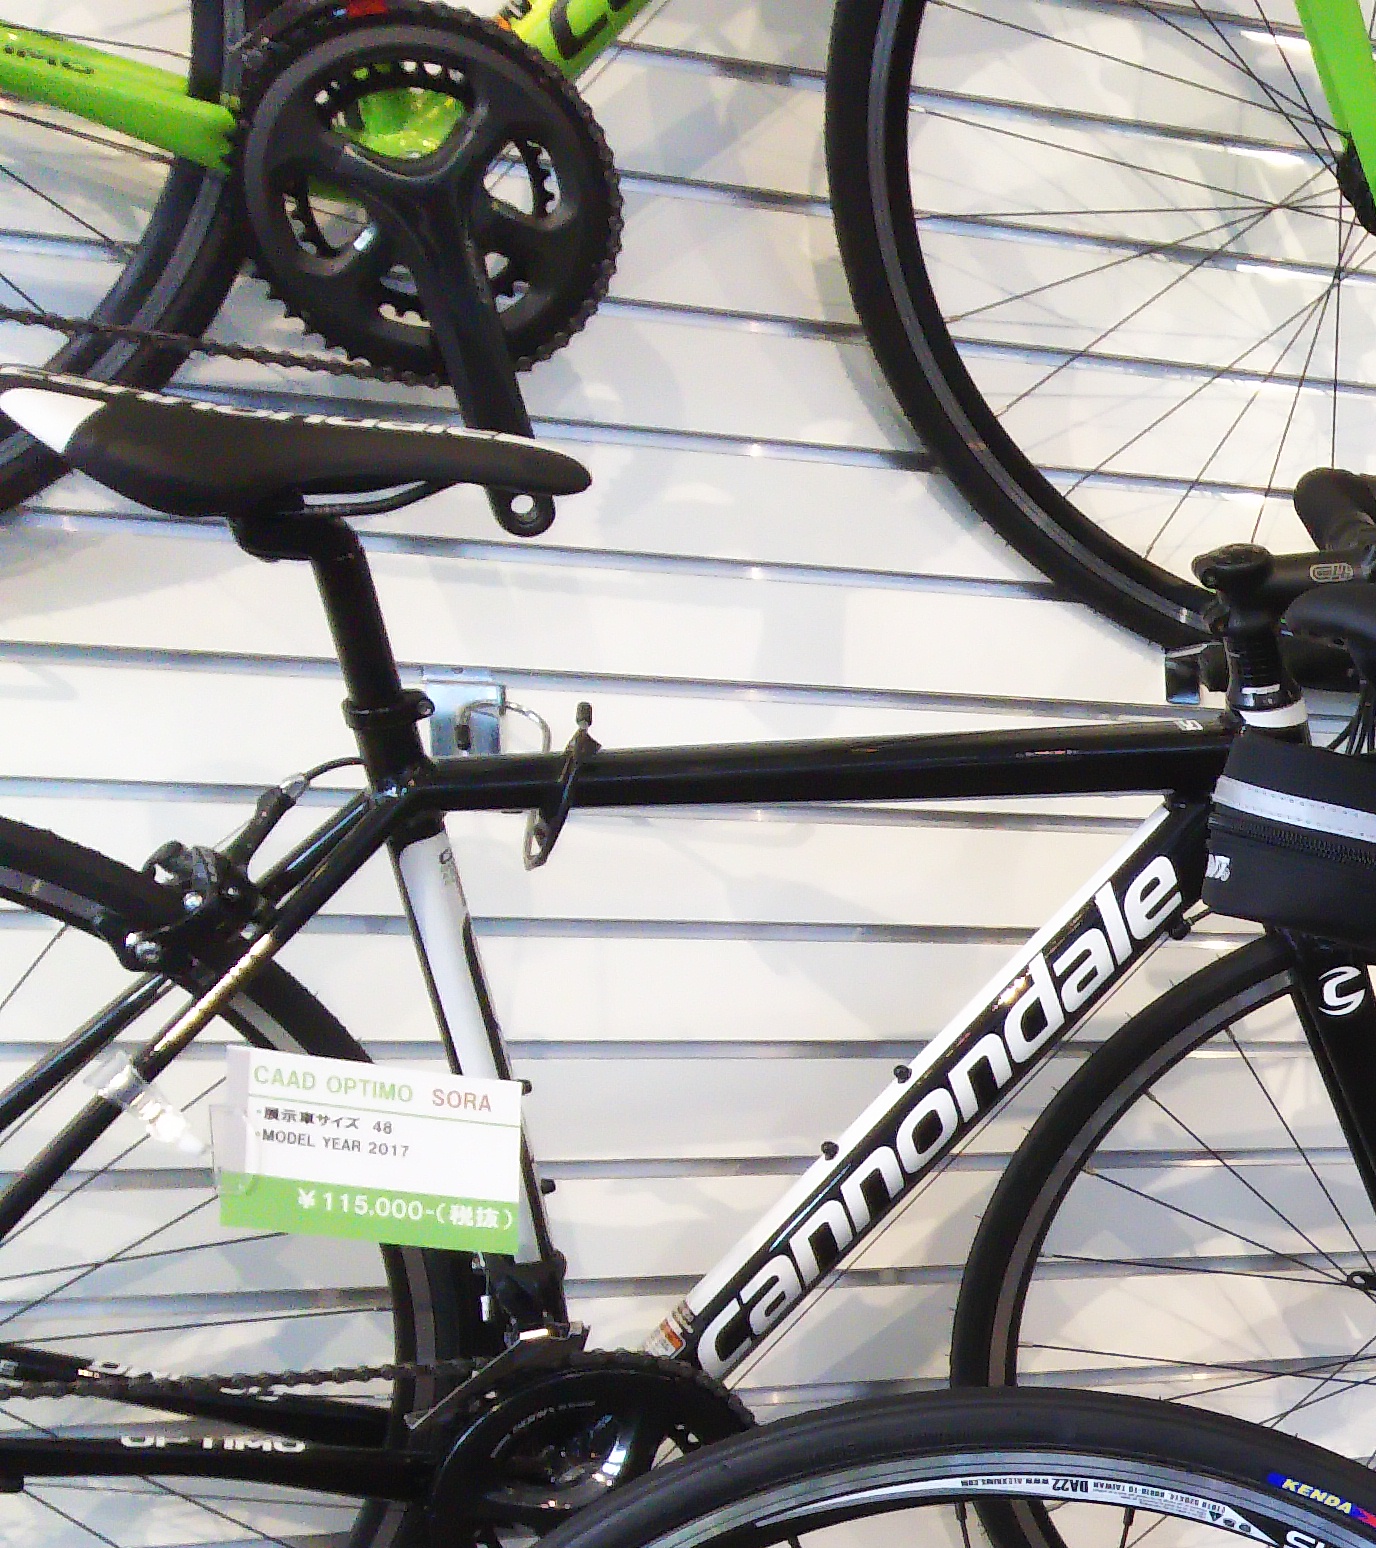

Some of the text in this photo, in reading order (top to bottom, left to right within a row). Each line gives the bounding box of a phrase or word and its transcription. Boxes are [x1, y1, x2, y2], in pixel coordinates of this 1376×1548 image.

[254, 1065, 492, 1113] CAAD OPTIMO SORA
[372, 1120, 393, 1135] 48
[693, 855, 1184, 1381] cannondale
[262, 1128, 410, 1158] MODEL YEAR 2017
[1051, 1477, 1090, 1495] DA22
[1281, 1477, 1355, 1517] KENDA
